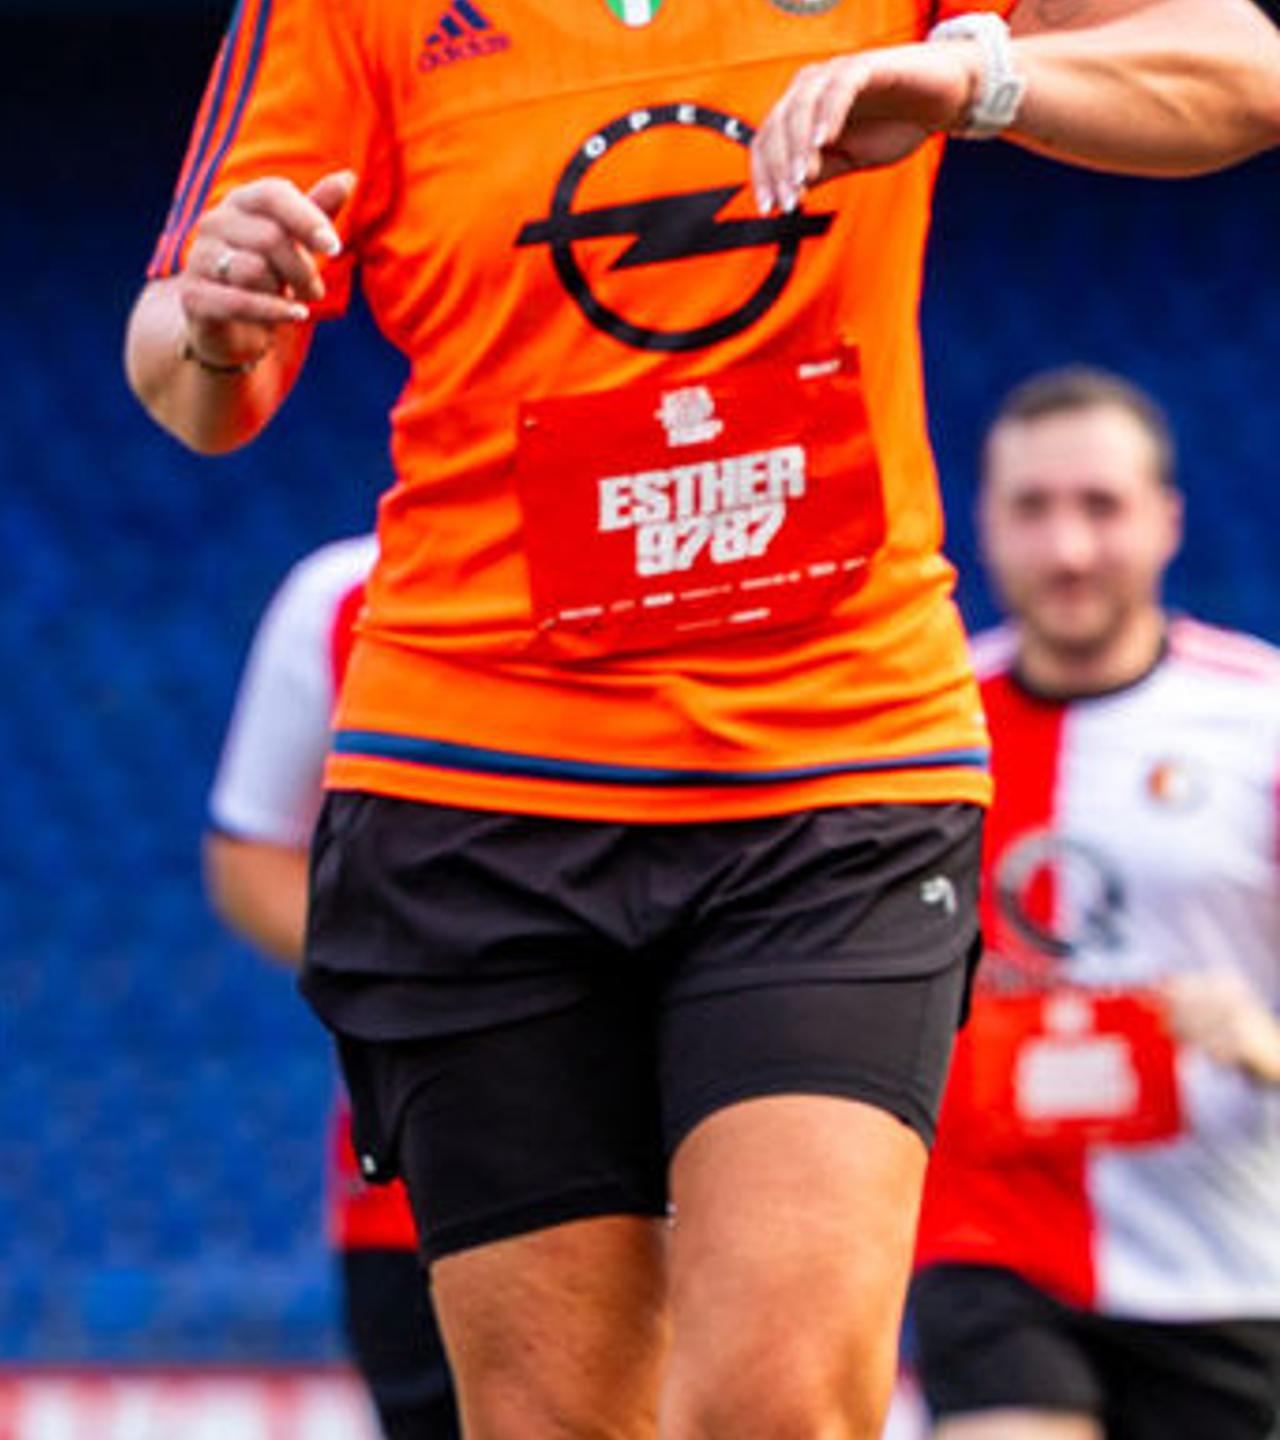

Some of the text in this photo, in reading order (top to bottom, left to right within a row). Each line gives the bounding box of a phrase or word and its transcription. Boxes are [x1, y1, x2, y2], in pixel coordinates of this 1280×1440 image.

[583, 102, 743, 160] OPEL
[598, 445, 806, 532] ESTHER
[635, 500, 786, 576] 9787
